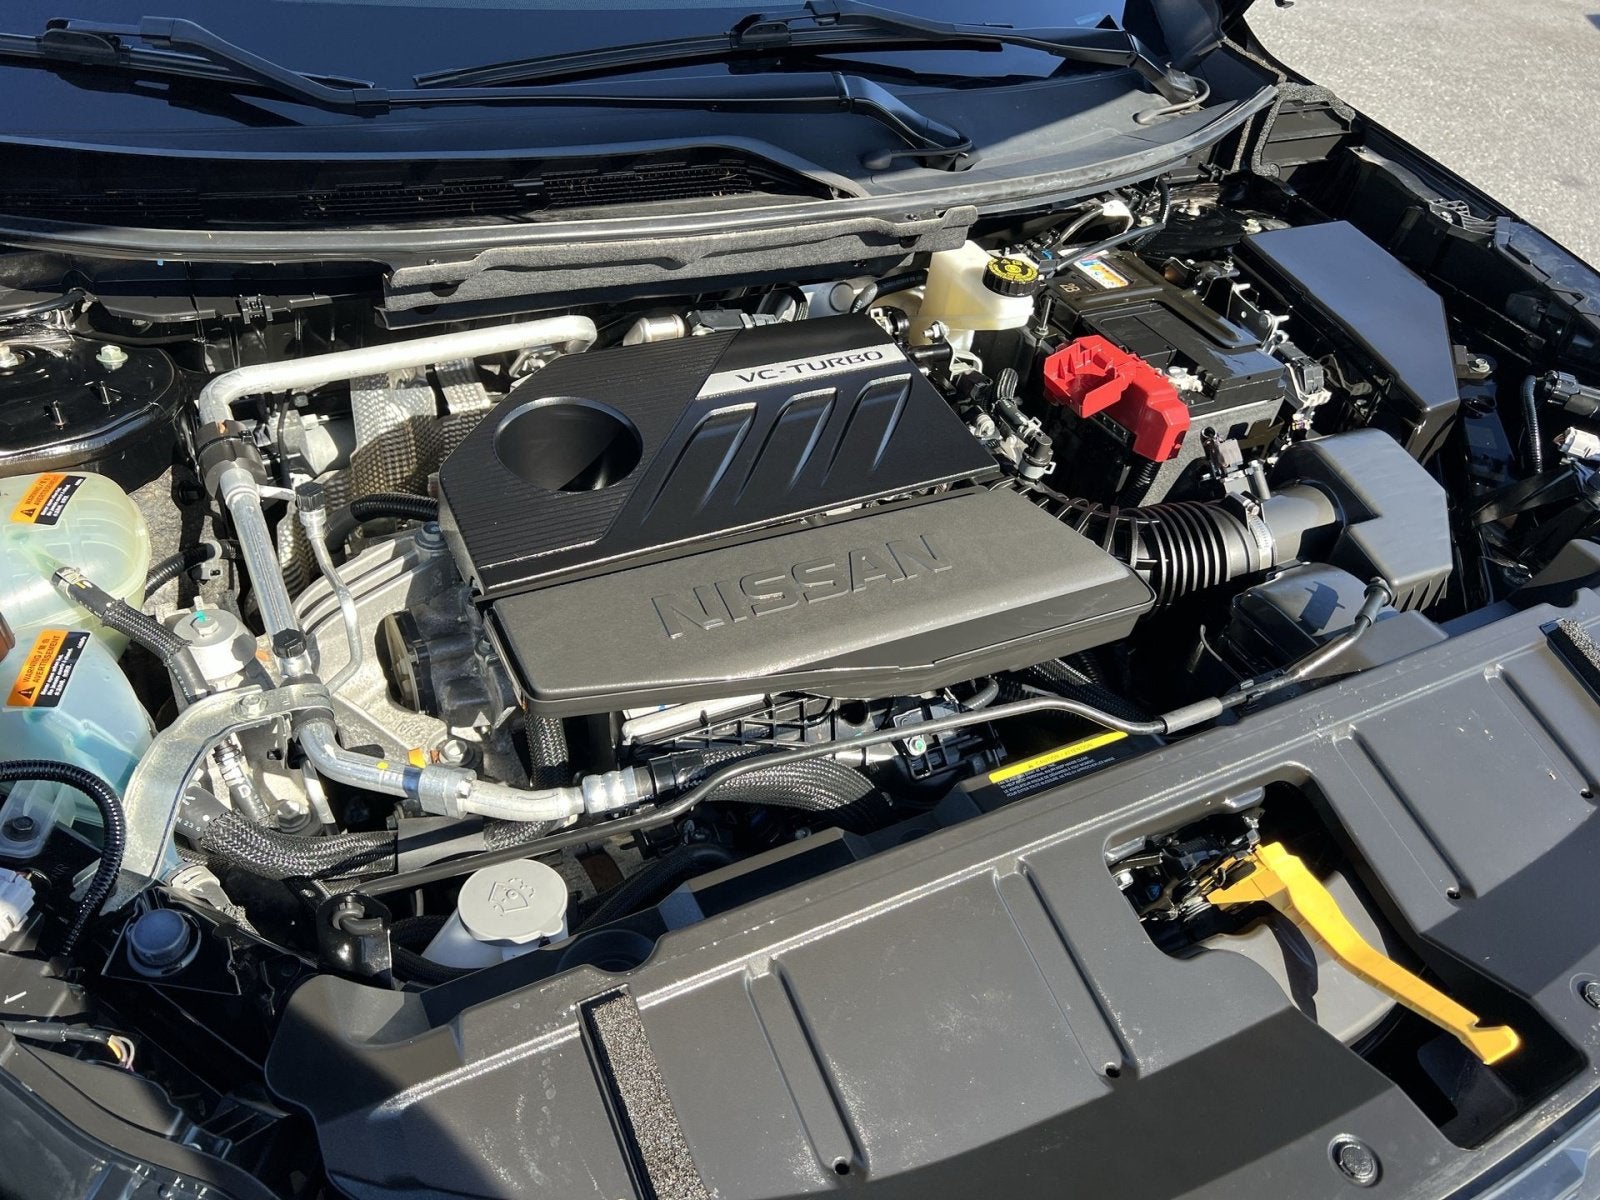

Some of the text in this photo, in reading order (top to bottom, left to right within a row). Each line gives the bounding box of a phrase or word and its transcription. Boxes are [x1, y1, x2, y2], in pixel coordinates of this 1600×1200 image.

[735, 350, 883, 383] VC-TURBO
[651, 535, 953, 640] NISSAN
[31, 634, 61, 683] AVERTISSEMENT
